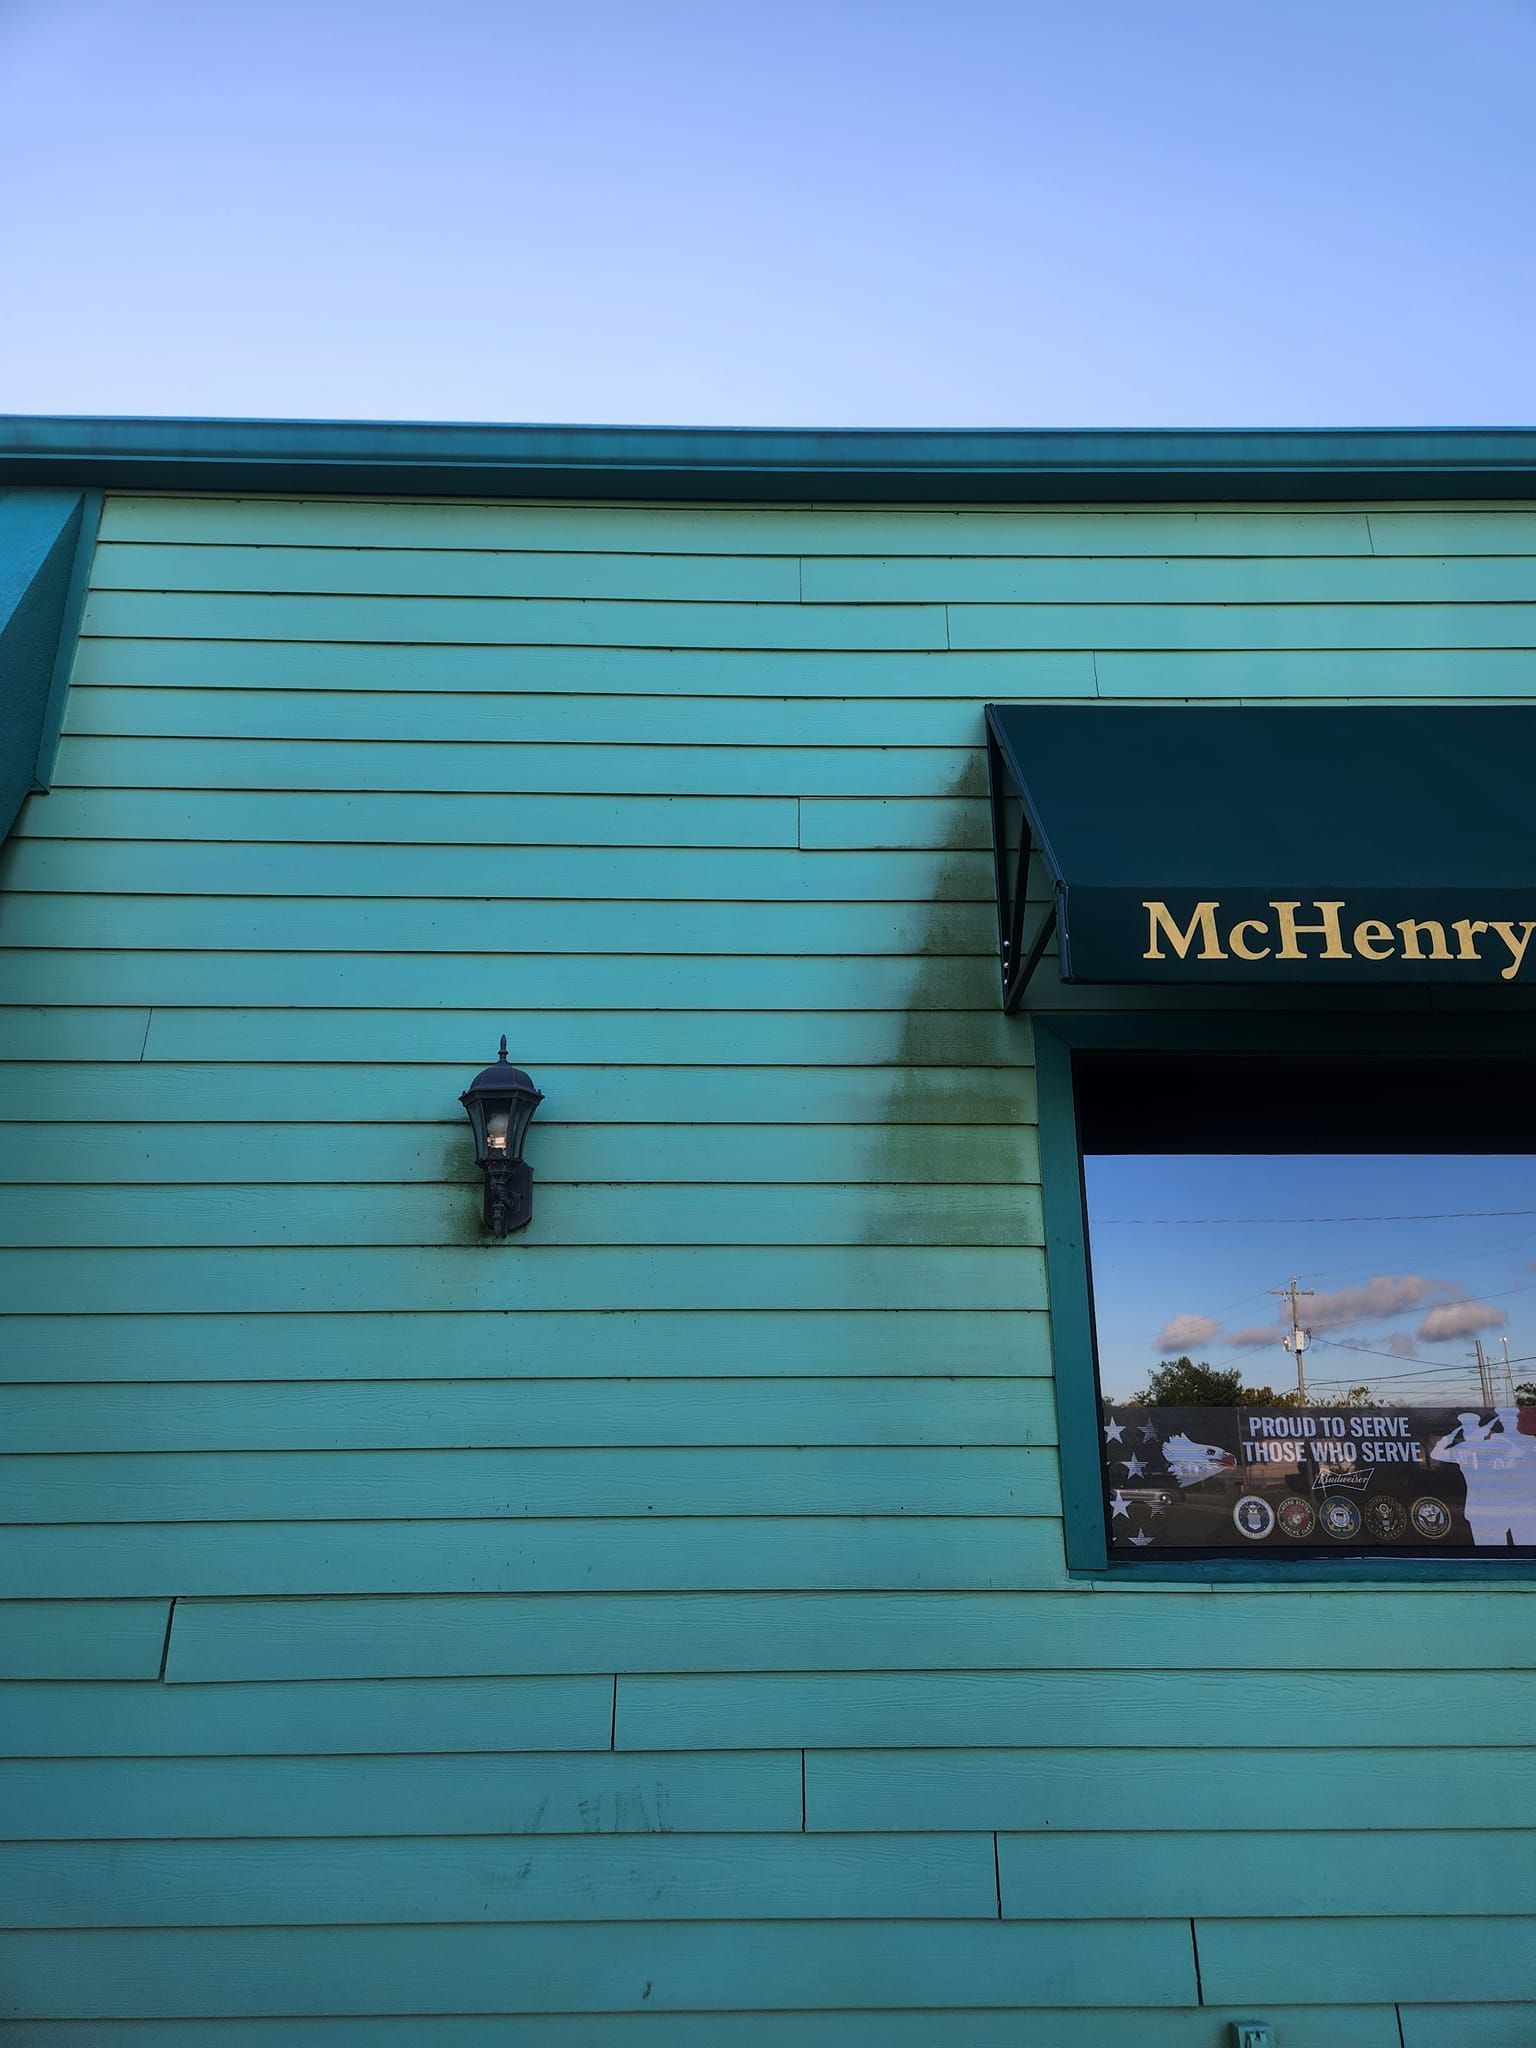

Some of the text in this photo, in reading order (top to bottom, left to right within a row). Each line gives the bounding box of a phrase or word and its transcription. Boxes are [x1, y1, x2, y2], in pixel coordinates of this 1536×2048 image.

[1142, 901, 1536, 980] McHenry
[1249, 1416, 1411, 1437] PROUD TO SERVE
[1242, 1441, 1423, 1462] THOSE WHO SERVE
[1317, 1471, 1369, 1485] Budweiser
